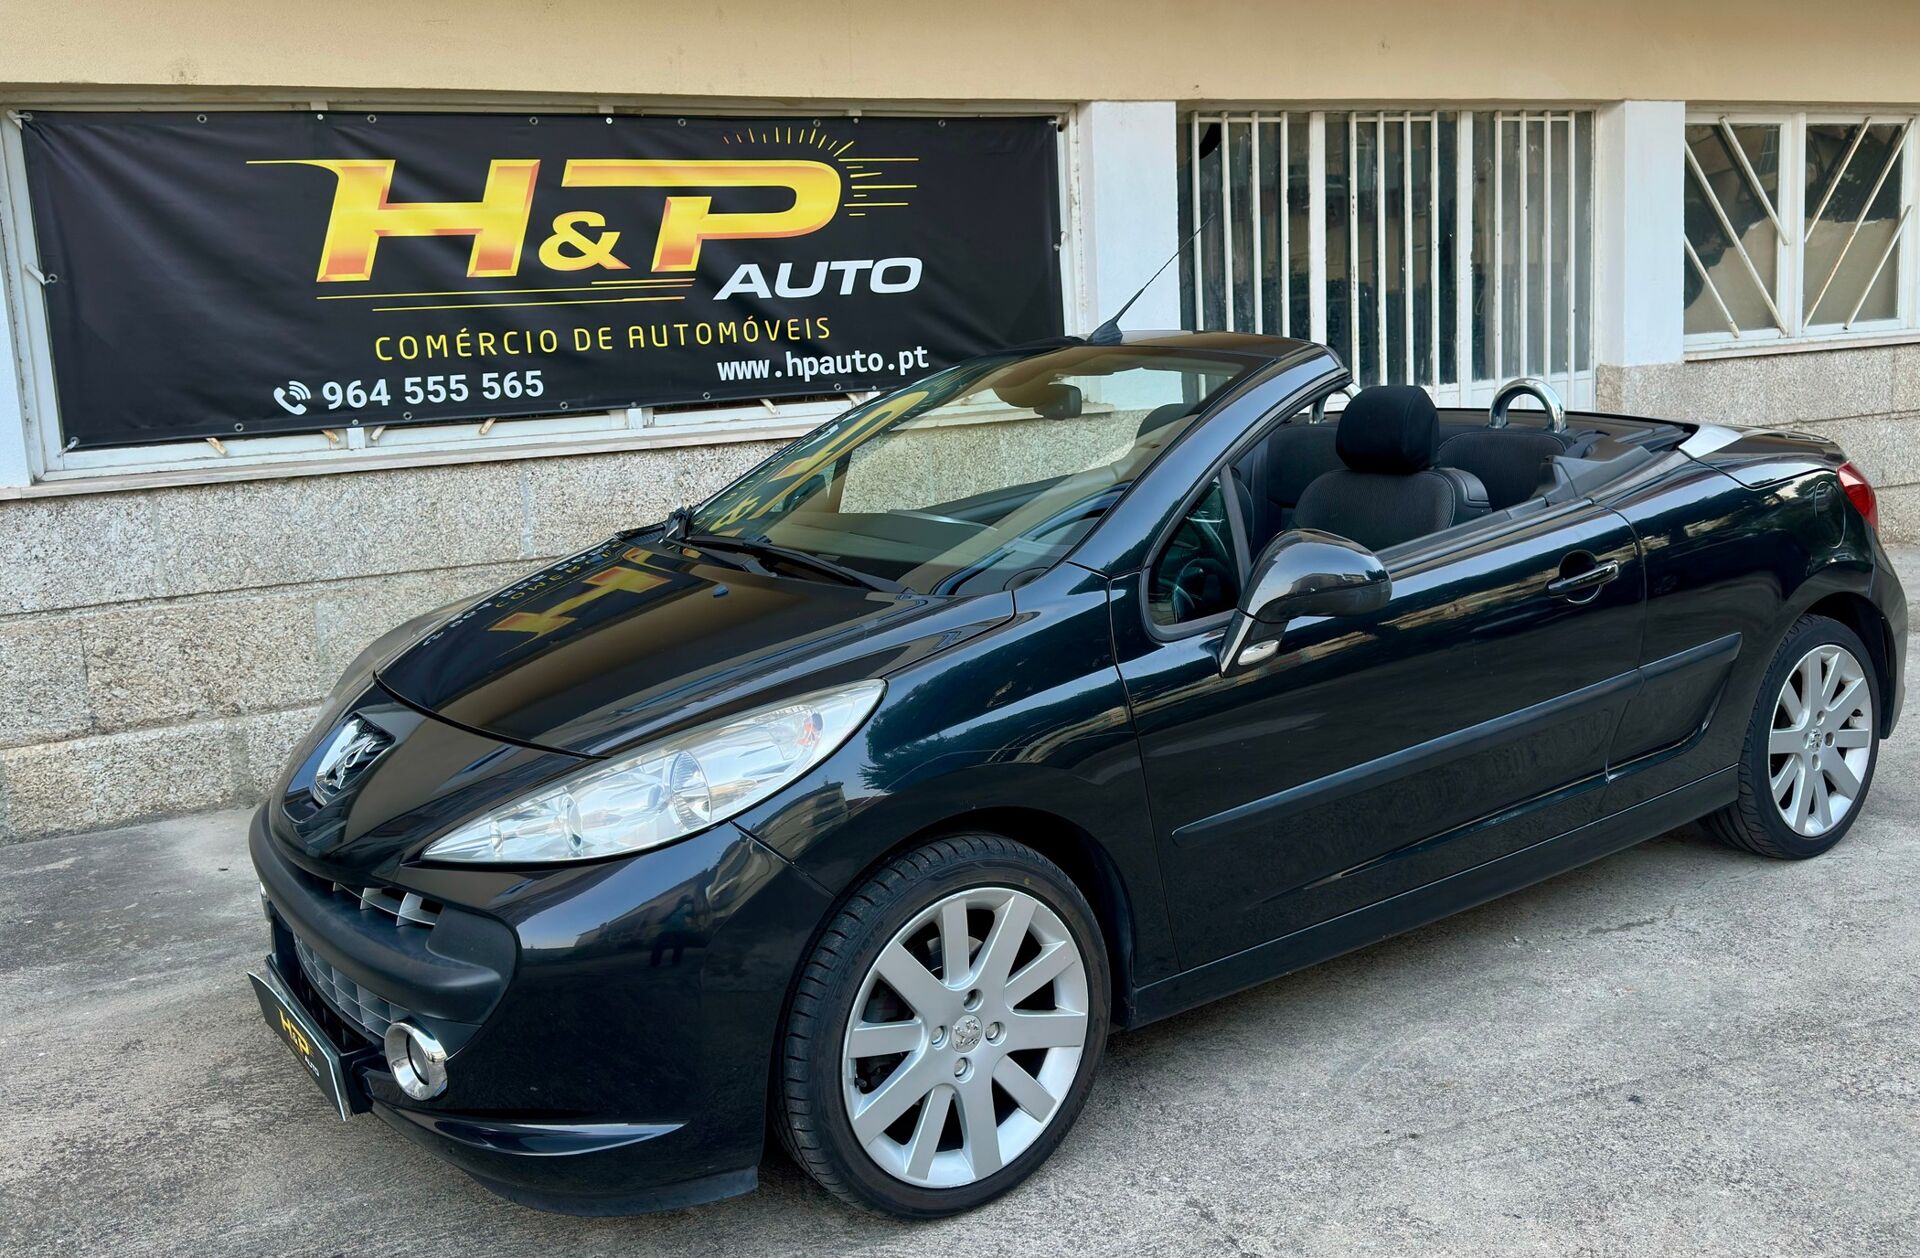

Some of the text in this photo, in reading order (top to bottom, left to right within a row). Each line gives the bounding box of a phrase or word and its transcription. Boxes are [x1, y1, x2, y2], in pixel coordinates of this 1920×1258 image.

[247, 158, 842, 283] H&P
[712, 257, 923, 300] AUTO
[375, 315, 831, 361] COMÉRCIO DE AUTOMÓVEIS
[717, 346, 929, 382] www.hpauto.pt
[322, 370, 544, 410] 964 555 565
